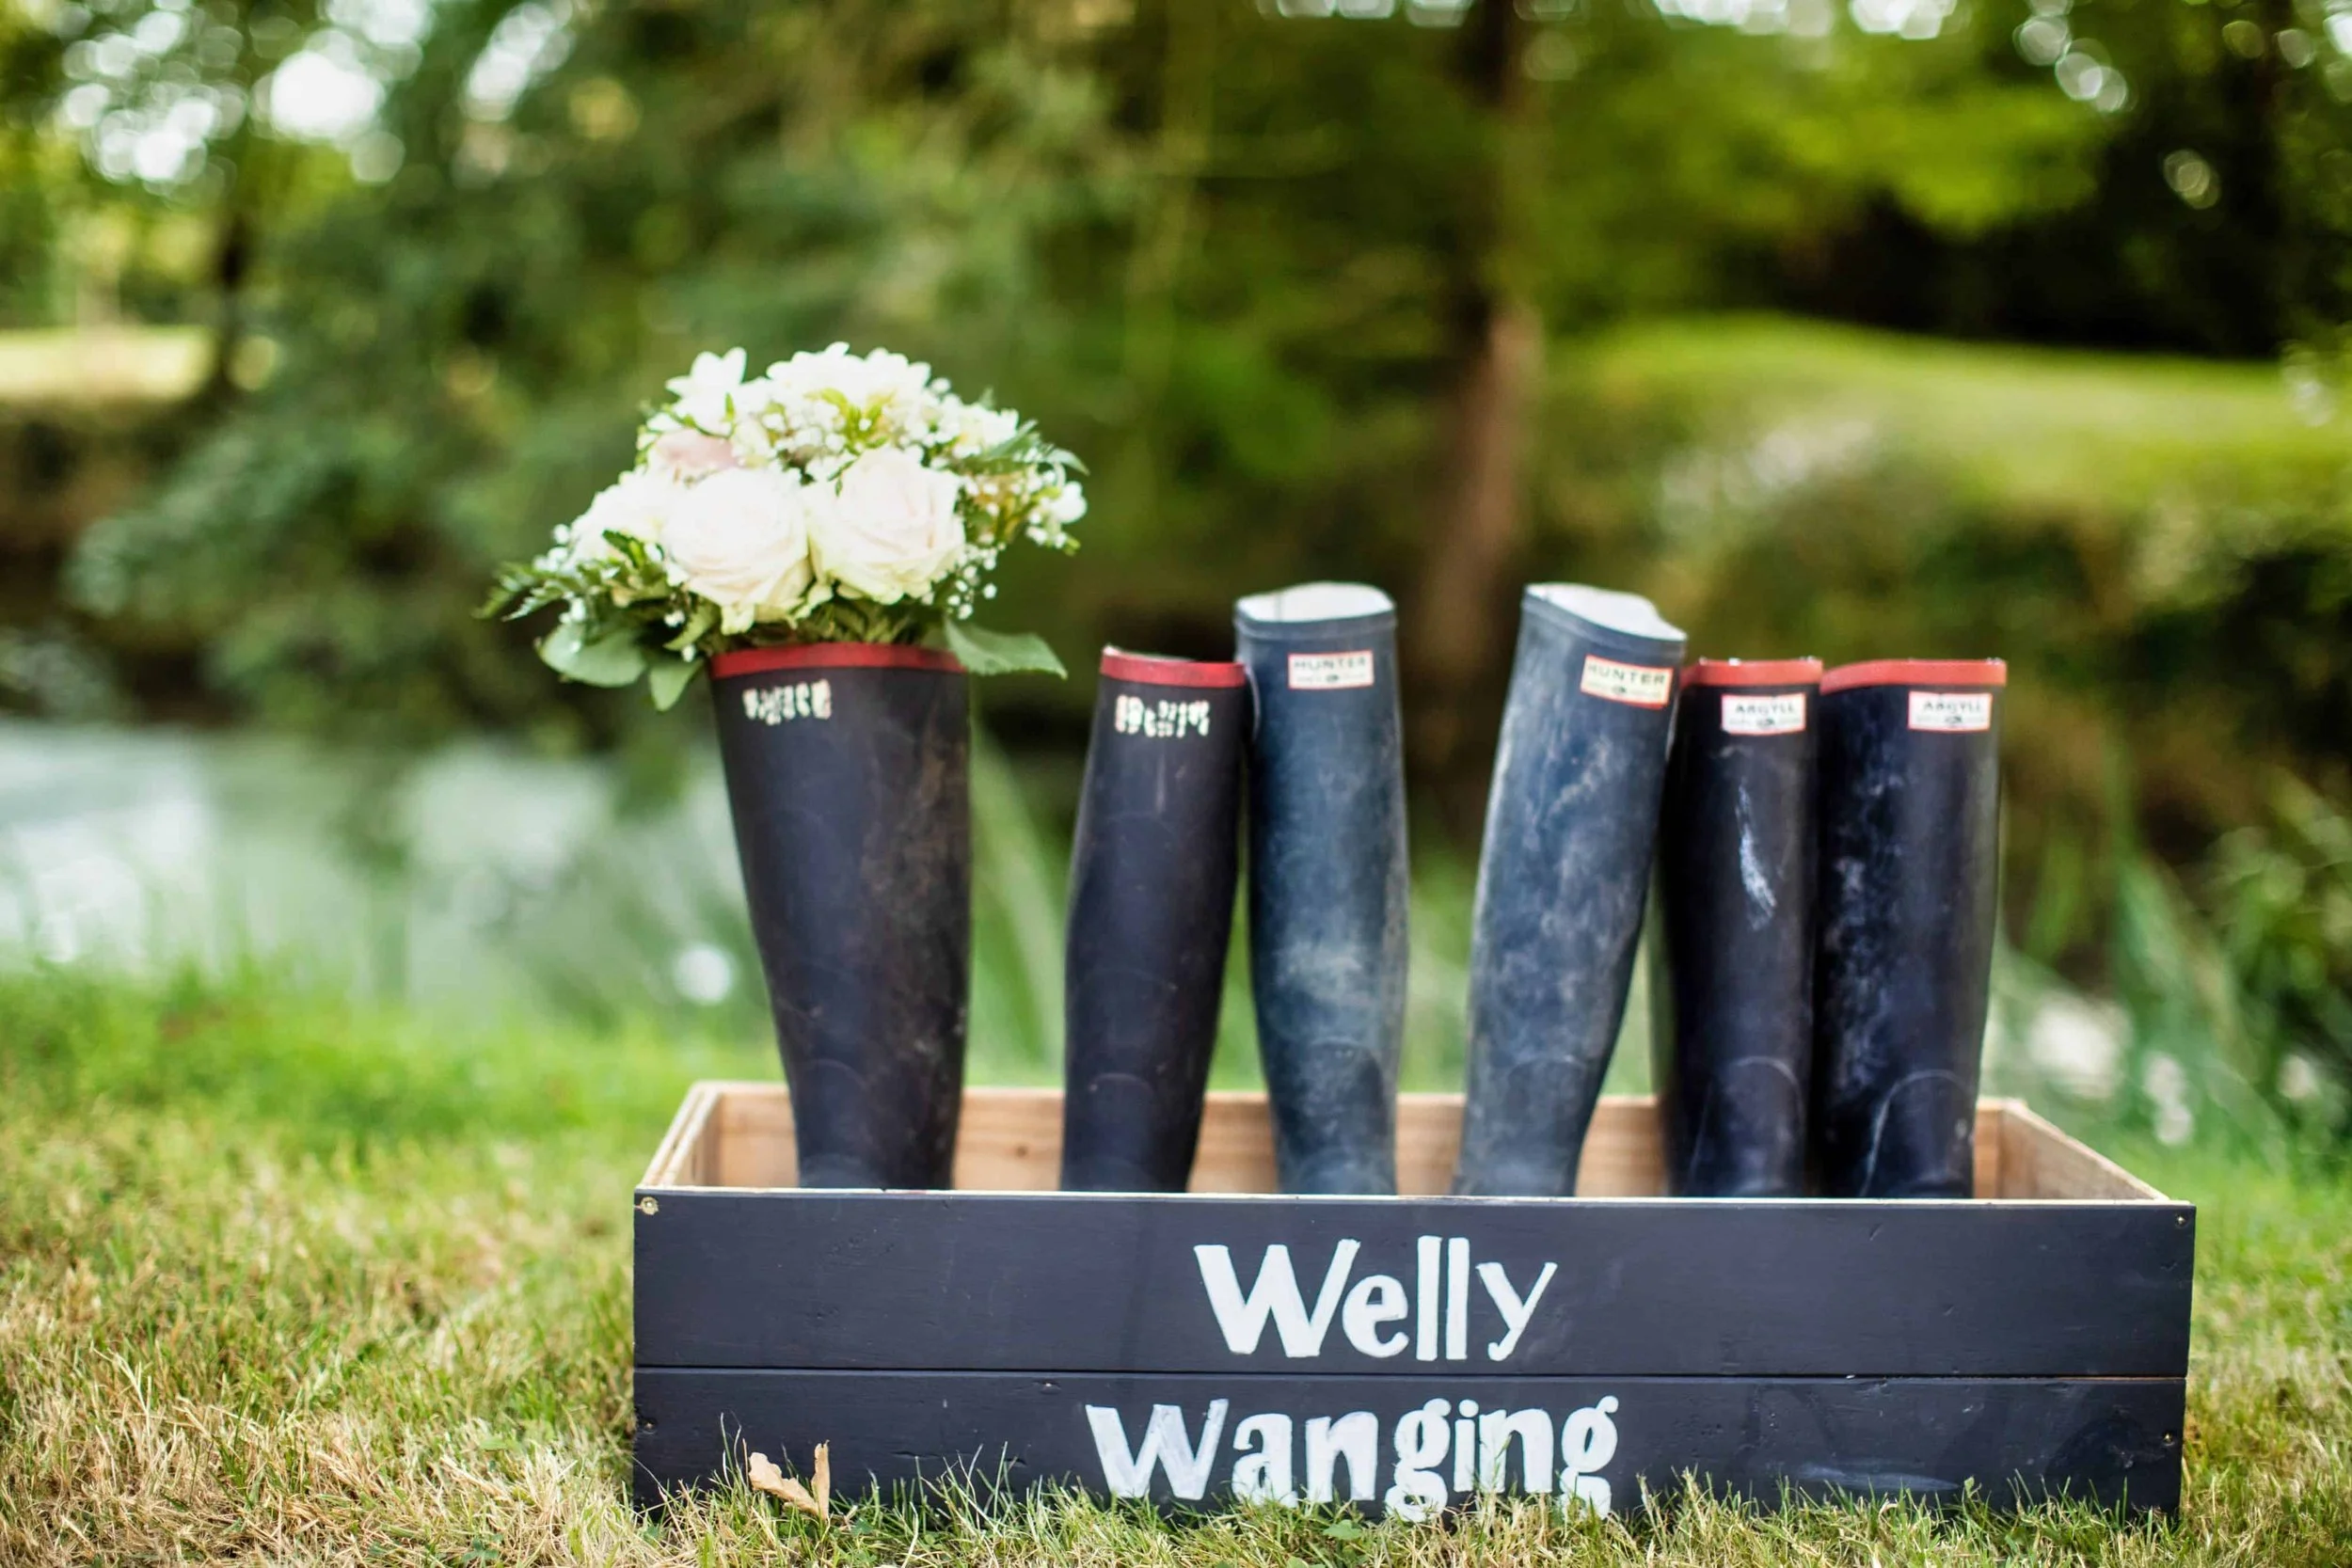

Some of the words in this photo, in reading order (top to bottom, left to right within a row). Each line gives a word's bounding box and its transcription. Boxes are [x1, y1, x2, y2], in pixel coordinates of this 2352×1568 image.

[1294, 657, 1366, 670] HUNTER
[1587, 664, 1666, 686] HUNTER
[1735, 703, 1795, 715] ARGYLL
[1193, 1235, 1558, 1362] Welly
[1085, 1396, 1619, 1523] Wanging
